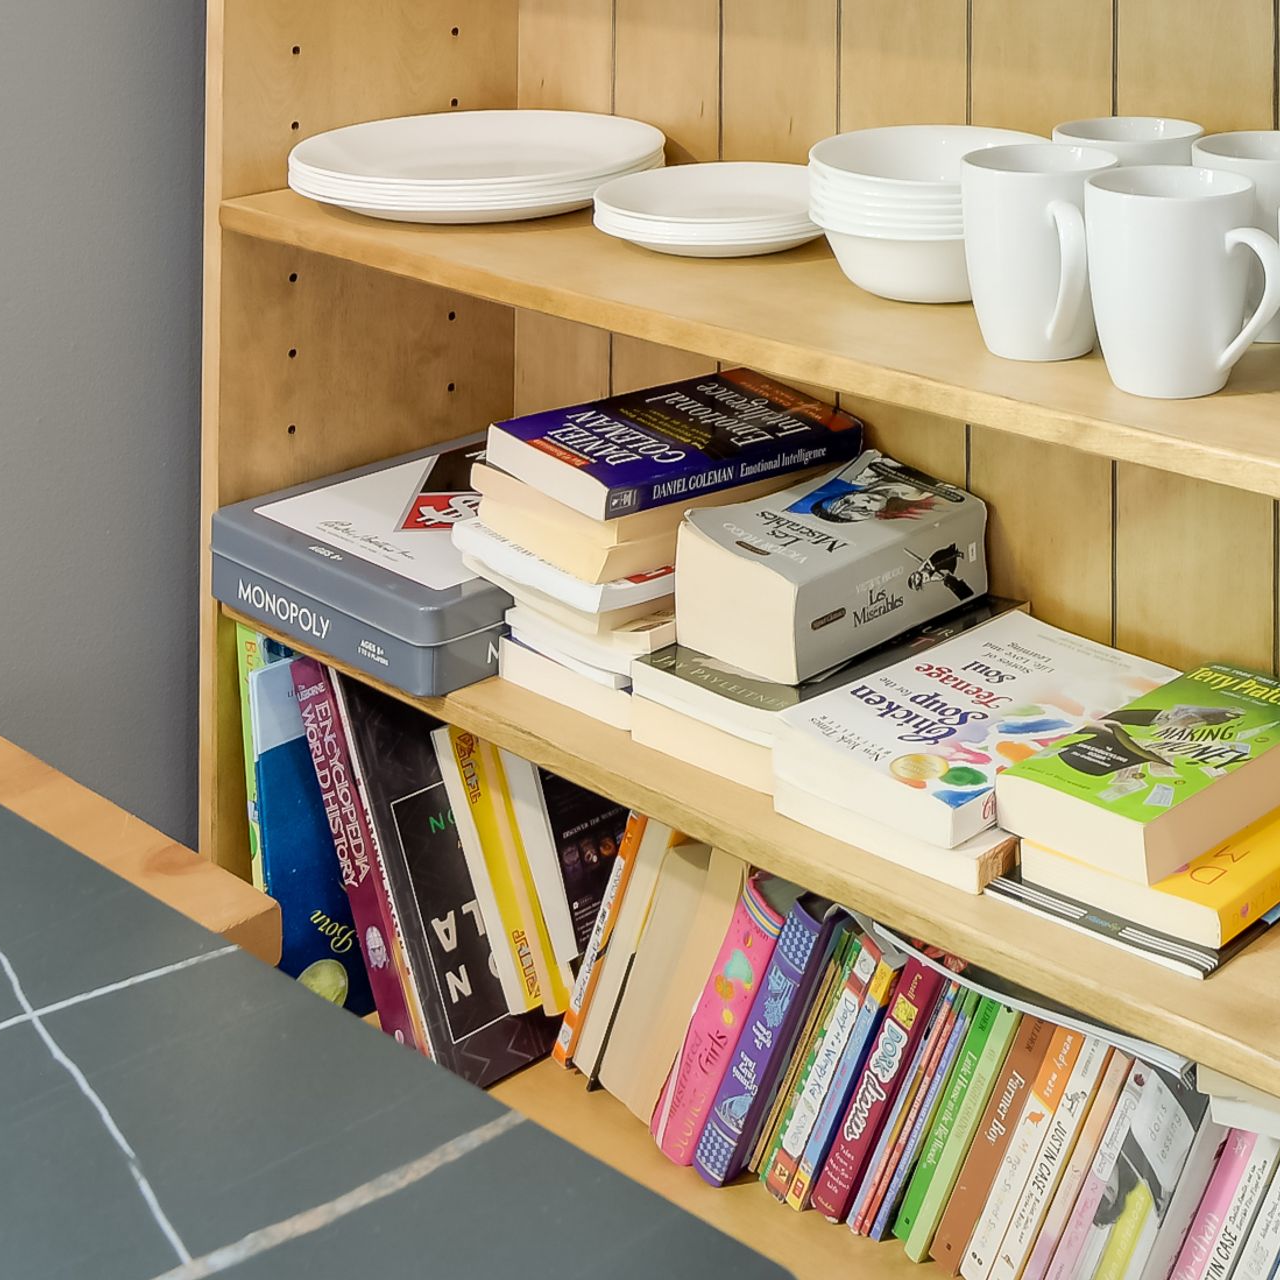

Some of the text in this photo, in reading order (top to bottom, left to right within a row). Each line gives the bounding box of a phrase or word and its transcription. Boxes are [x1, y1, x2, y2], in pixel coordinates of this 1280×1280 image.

[645, 390, 774, 448] Emotional
[695, 381, 812, 439] Intelligence
[547, 428, 643, 466] DANIEL
[566, 410, 687, 464] GOLEMAN
[652, 446, 828, 501] DANIEL GOLEMAN Emotional Intelligence
[765, 529, 802, 548] Les
[237, 578, 331, 640] MONOPOLY
[868, 587, 886, 605] Les
[360, 639, 379, 653] AGES
[915, 662, 1014, 709] Teenage
[962, 660, 1016, 686] Soul
[1186, 667, 1241, 690] Terry
[850, 684, 958, 745] Chicken
[910, 690, 989, 729] Soup
[1150, 725, 1235, 742] MAKING
[301, 702, 359, 889] WORLD HISTORY
[315, 700, 371, 883] ENCYCLOPEDIA
[310, 909, 356, 954] Born
[837, 996, 857, 1034] Diary
[696, 1028, 729, 1077] Girls
[817, 1046, 836, 1085] Wimpy
[873, 1021, 903, 1083] DORK
[958, 1050, 978, 1077] Little
[1043, 1034, 1075, 1098] wendy mass
[809, 1078, 824, 1102] Kid
[845, 1071, 886, 1141] Diaries
[947, 1073, 968, 1102] House
[984, 1070, 1026, 1147] Farmer Boy
[1148, 1103, 1169, 1143] doris
[1158, 1114, 1183, 1166] lessing
[840, 1144, 855, 1161] Tales
[1031, 1120, 1068, 1197] JUSTIN CASE
[1219, 1225, 1239, 1261] CASE
